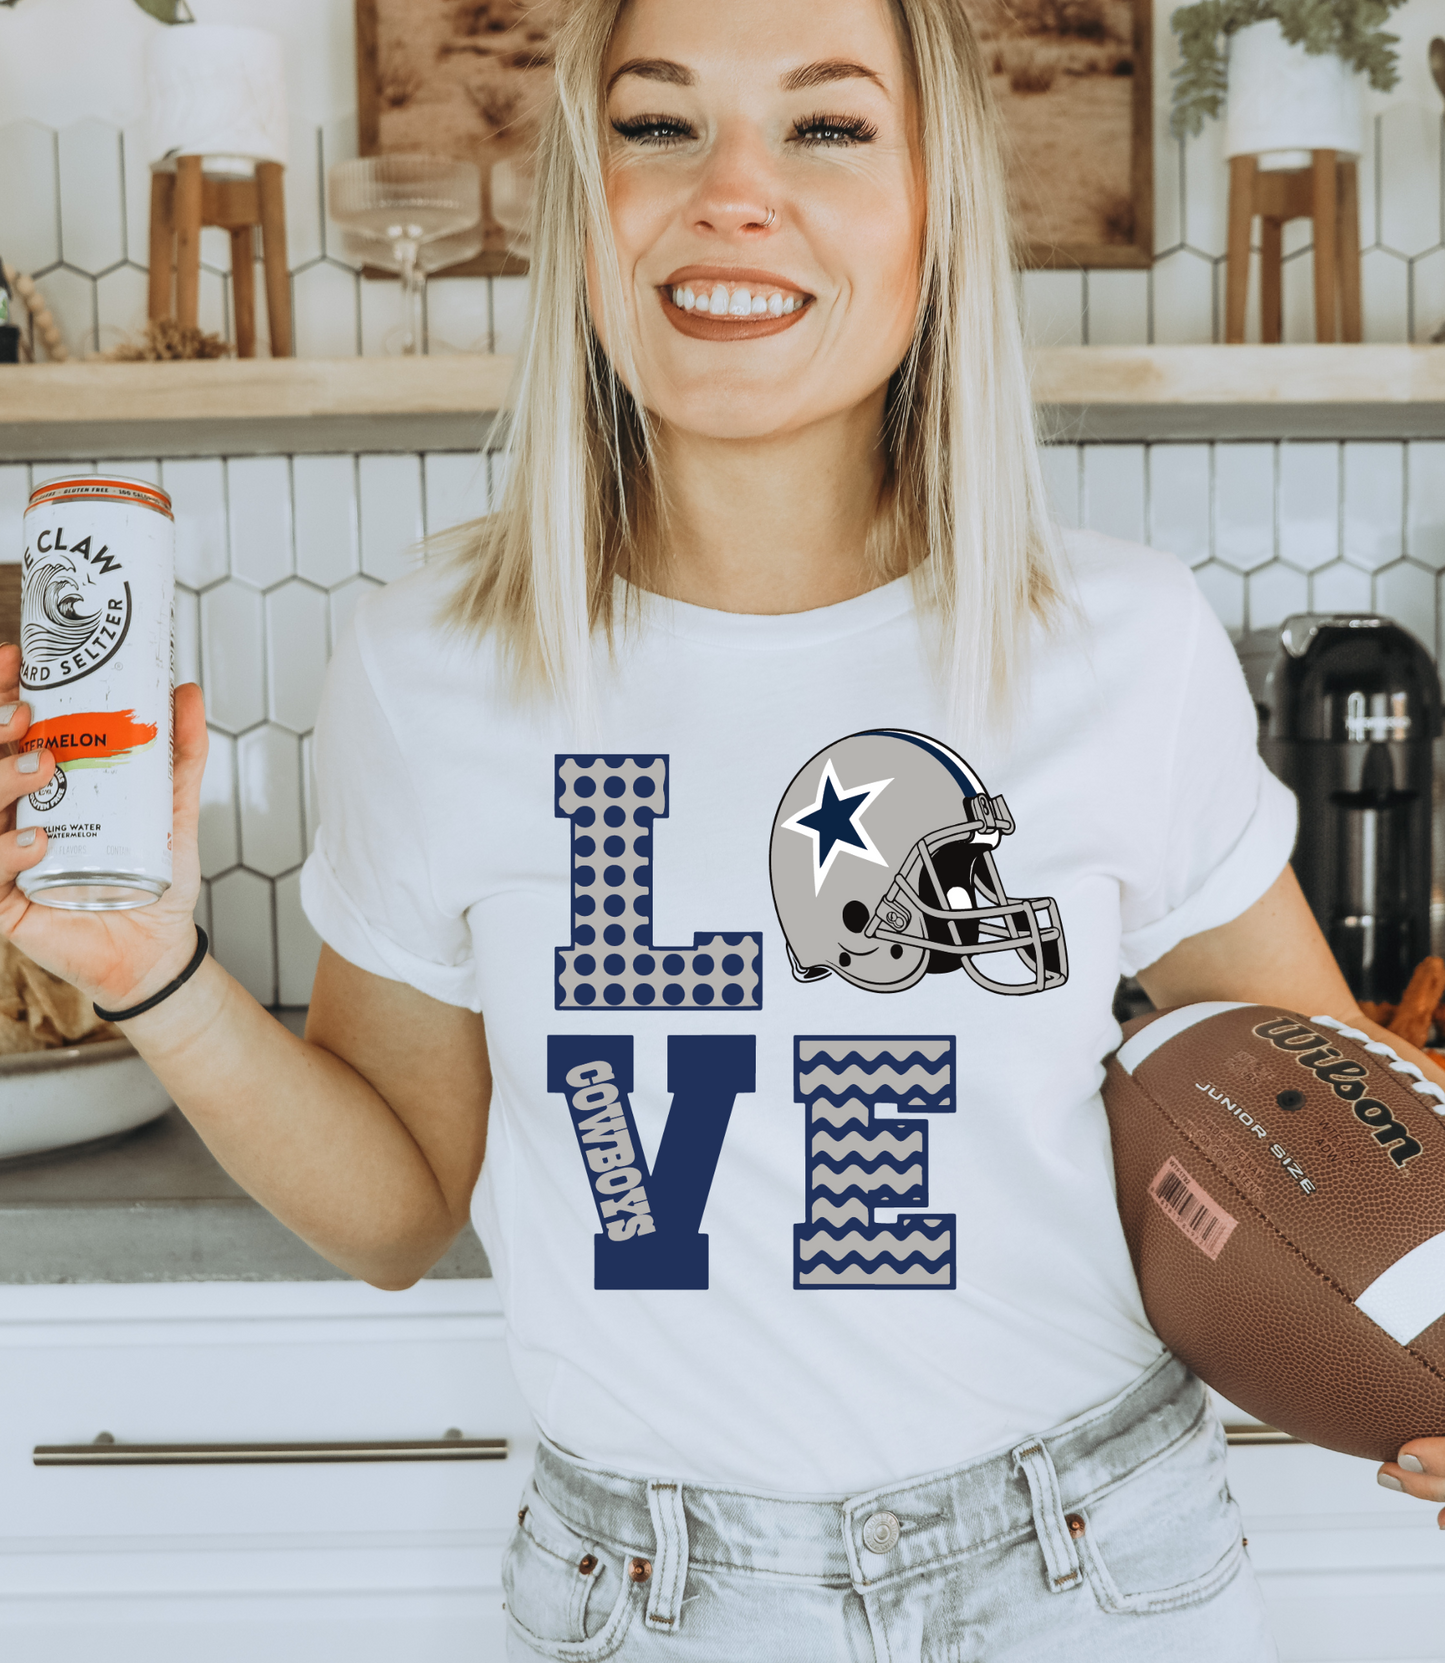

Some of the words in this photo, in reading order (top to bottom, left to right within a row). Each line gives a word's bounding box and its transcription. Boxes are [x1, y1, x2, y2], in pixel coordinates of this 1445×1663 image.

[37, 527, 123, 575] CLAW
[60, 598, 123, 675] SELTZER
[18, 733, 107, 754] ATERMELON
[47, 831, 98, 840] WATERMELON
[69, 823, 102, 831] WATER
[1252, 1015, 1424, 1169] Wilson
[565, 1060, 656, 1242] COWBOYS
[1195, 1081, 1268, 1139] JUNIOR
[1270, 1143, 1317, 1195] SIZE
[1202, 1118, 1225, 1139] MADE
[1232, 1146, 1265, 1180] VIETNAM
[1314, 1138, 1341, 1162] ADW
